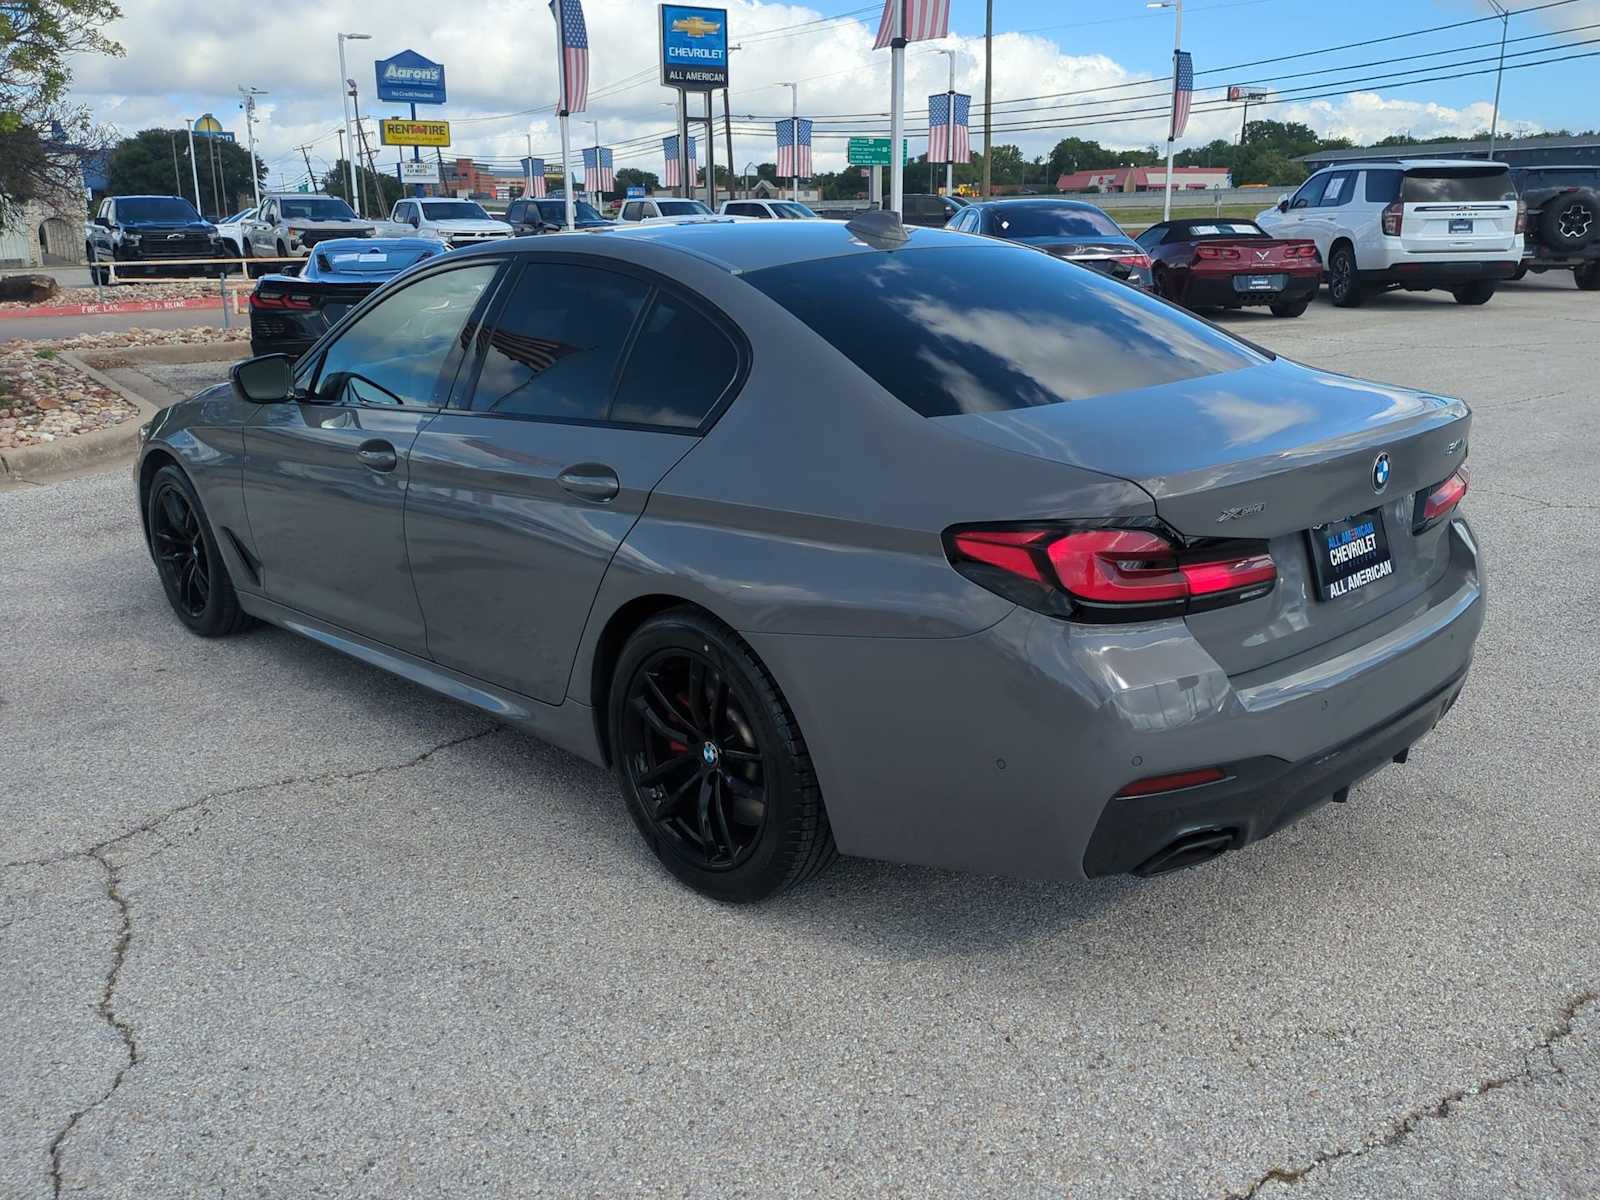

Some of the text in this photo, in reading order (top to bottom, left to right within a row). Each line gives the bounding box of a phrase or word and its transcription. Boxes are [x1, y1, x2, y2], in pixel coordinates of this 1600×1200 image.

[668, 46, 724, 59] CHEVROLET
[669, 70, 725, 82] ALL AMERICAN
[387, 124, 415, 135] RENT
[1327, 521, 1376, 550] ALL AMERICAN
[1329, 533, 1377, 567] CHEVROLET
[1330, 578, 1348, 599] ALL
[1347, 559, 1393, 591] AMERICAN
